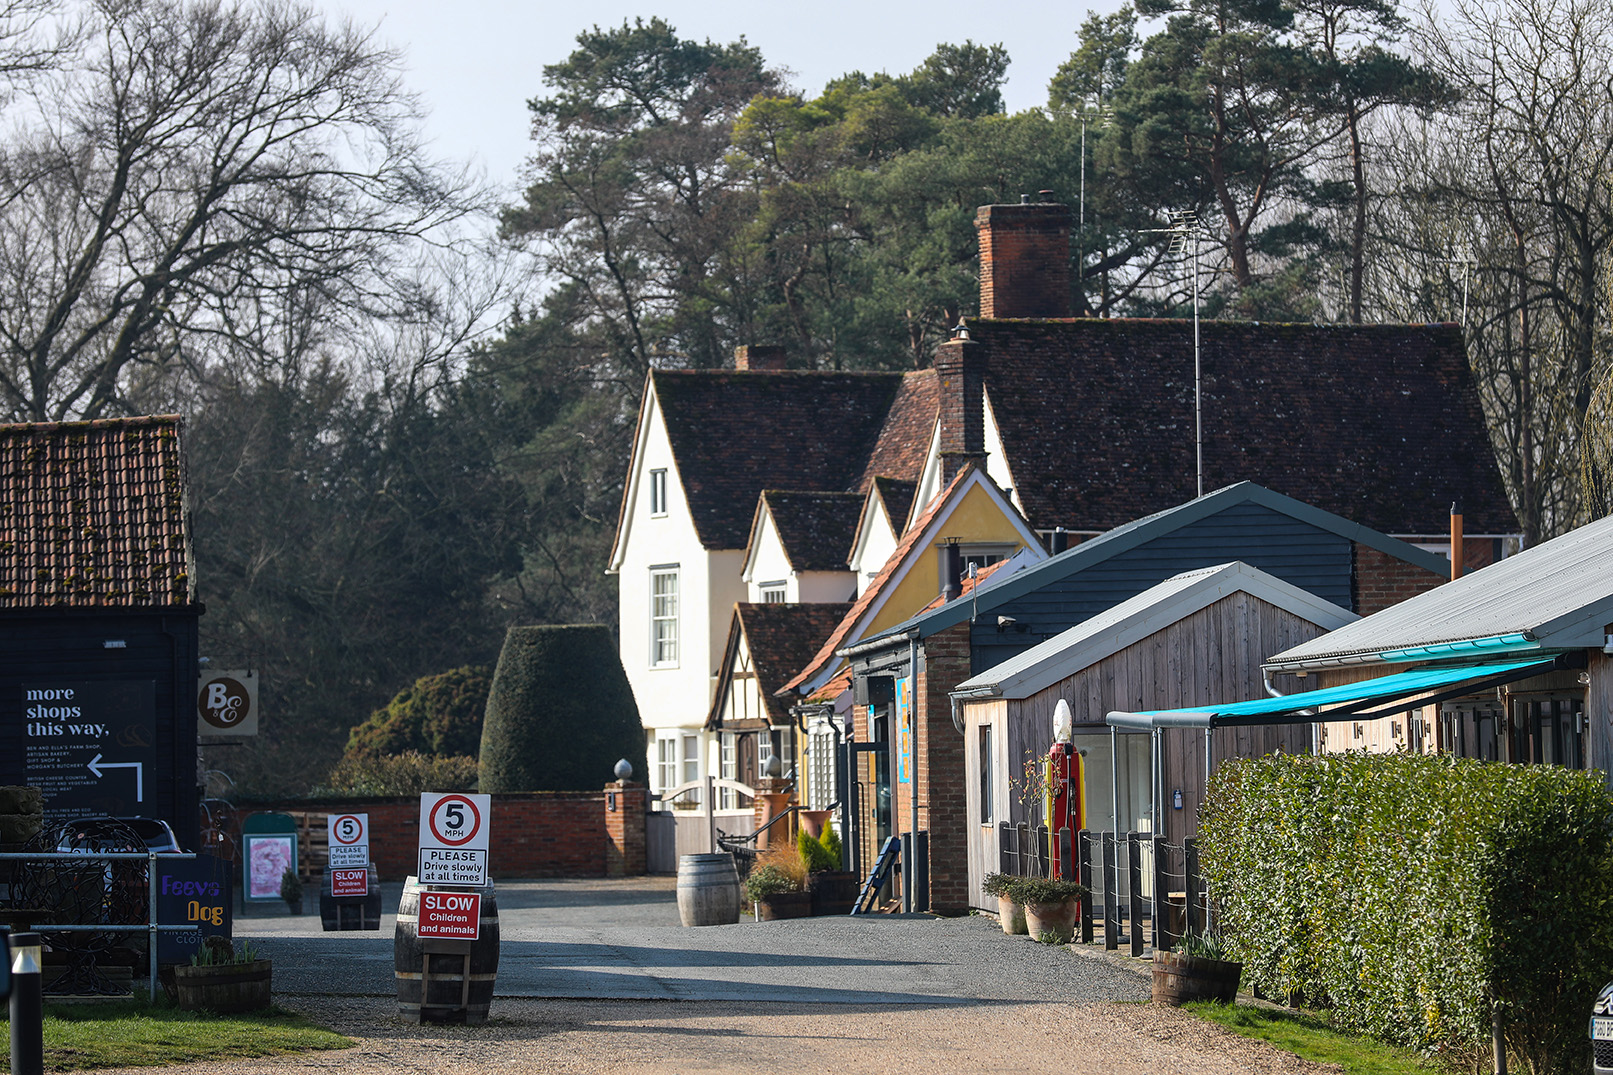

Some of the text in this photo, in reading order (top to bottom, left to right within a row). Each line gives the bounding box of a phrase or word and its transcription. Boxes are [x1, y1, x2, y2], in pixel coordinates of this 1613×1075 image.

[26, 688, 74, 700] more
[26, 704, 81, 721] shops
[26, 722, 110, 738] this way,
[446, 804, 464, 829] 5
[343, 820, 353, 835] 5
[431, 852, 476, 861] PLEASE
[424, 862, 482, 873] Drive slowly
[335, 872, 363, 880] SLOW
[439, 872, 450, 880] all
[453, 873, 480, 882] times
[425, 896, 474, 911] SLOW
[187, 900, 224, 926] Dog
[429, 912, 468, 922] Children
[440, 926, 475, 934] animals
